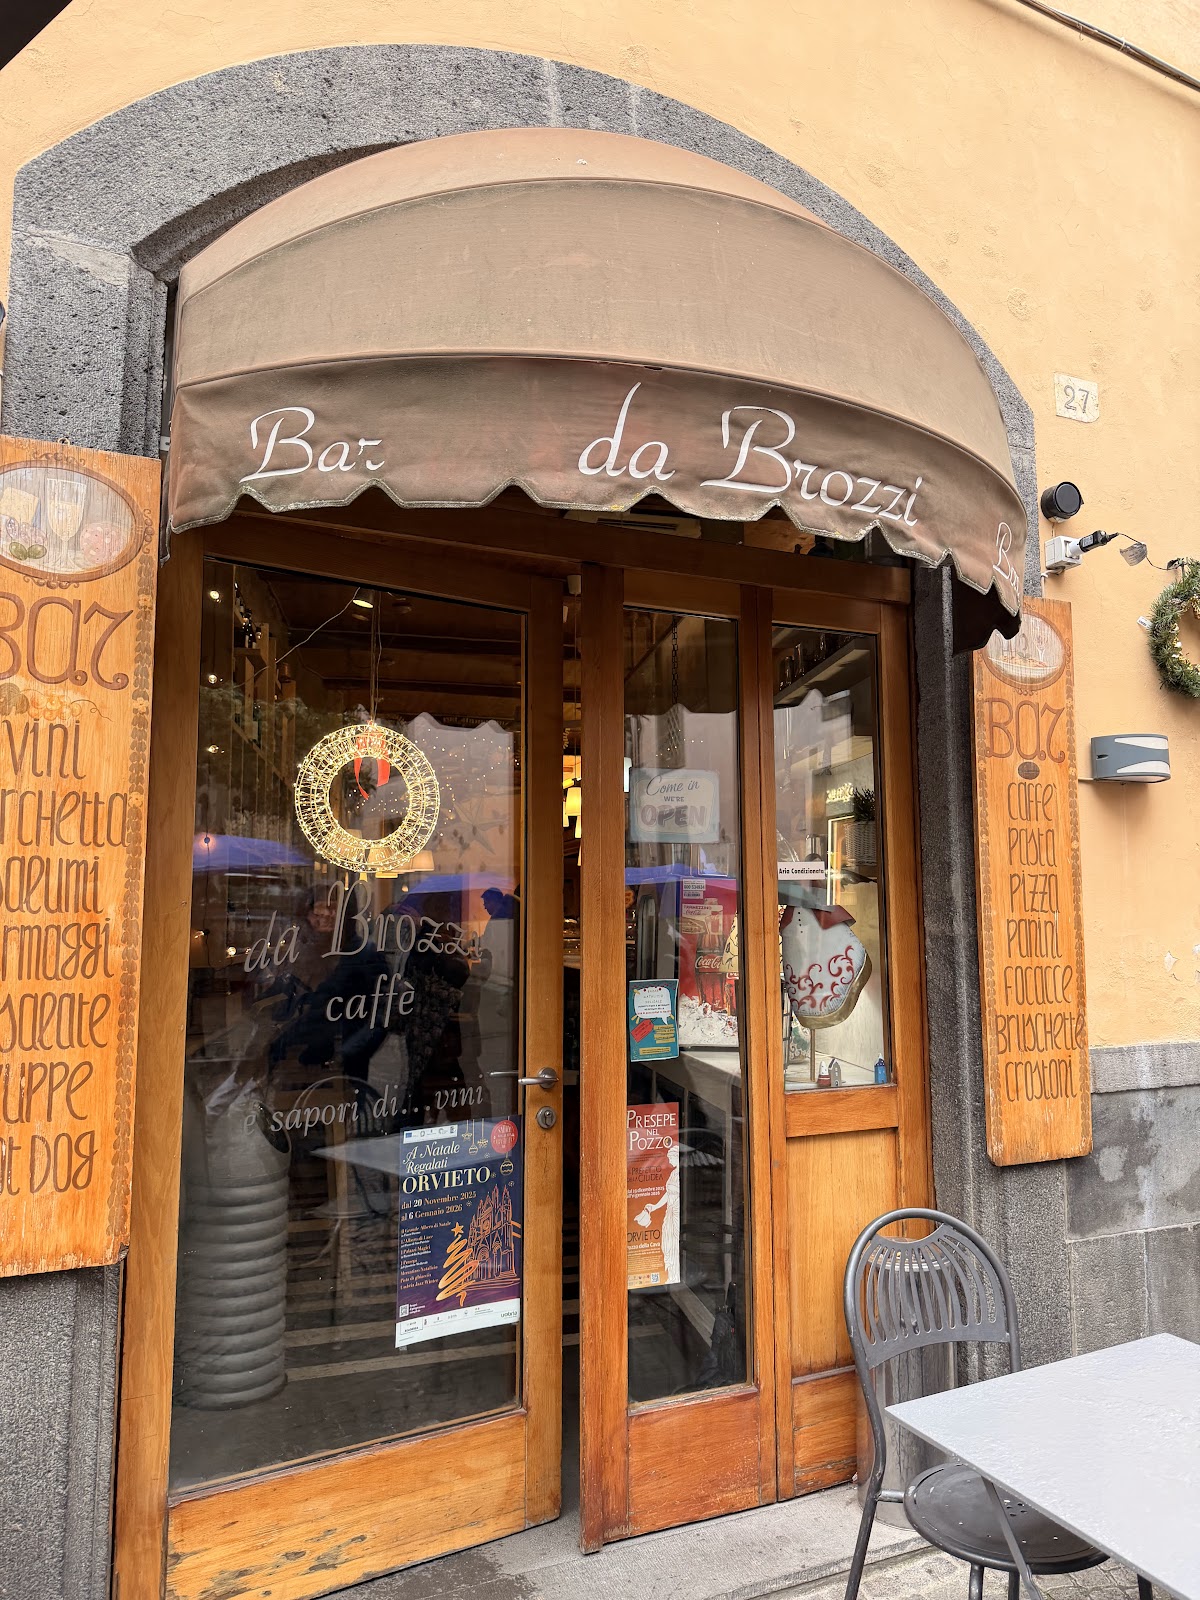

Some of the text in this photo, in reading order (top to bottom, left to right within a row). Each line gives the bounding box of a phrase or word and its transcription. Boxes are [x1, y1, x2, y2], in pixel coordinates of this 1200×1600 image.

[1063, 384, 1091, 415] 27
[239, 382, 919, 527] Bar da Brozzi
[984, 697, 1066, 764] Bar
[2, 718, 87, 780] vini
[646, 775, 700, 796] Come in
[640, 804, 706, 828] OPEN
[0, 855, 104, 914] alumi
[243, 879, 483, 973] da Brozzi
[326, 973, 416, 1029] caffè
[0, 1061, 93, 1124] uppe
[270, 1089, 359, 1137] sapori
[627, 1110, 677, 1129] PRESEPE
[403, 1141, 461, 1164] A Natale
[629, 1131, 673, 1151] POZZO
[402, 1166, 491, 1194] ORVIETO
[406, 1157, 448, 1175] Regalati
[401, 1191, 477, 1210] dal 20 Novembre 2025
[401, 1204, 463, 1221] al 6 Gennaio 2026
[627, 1229, 661, 1243] ORVIETO
